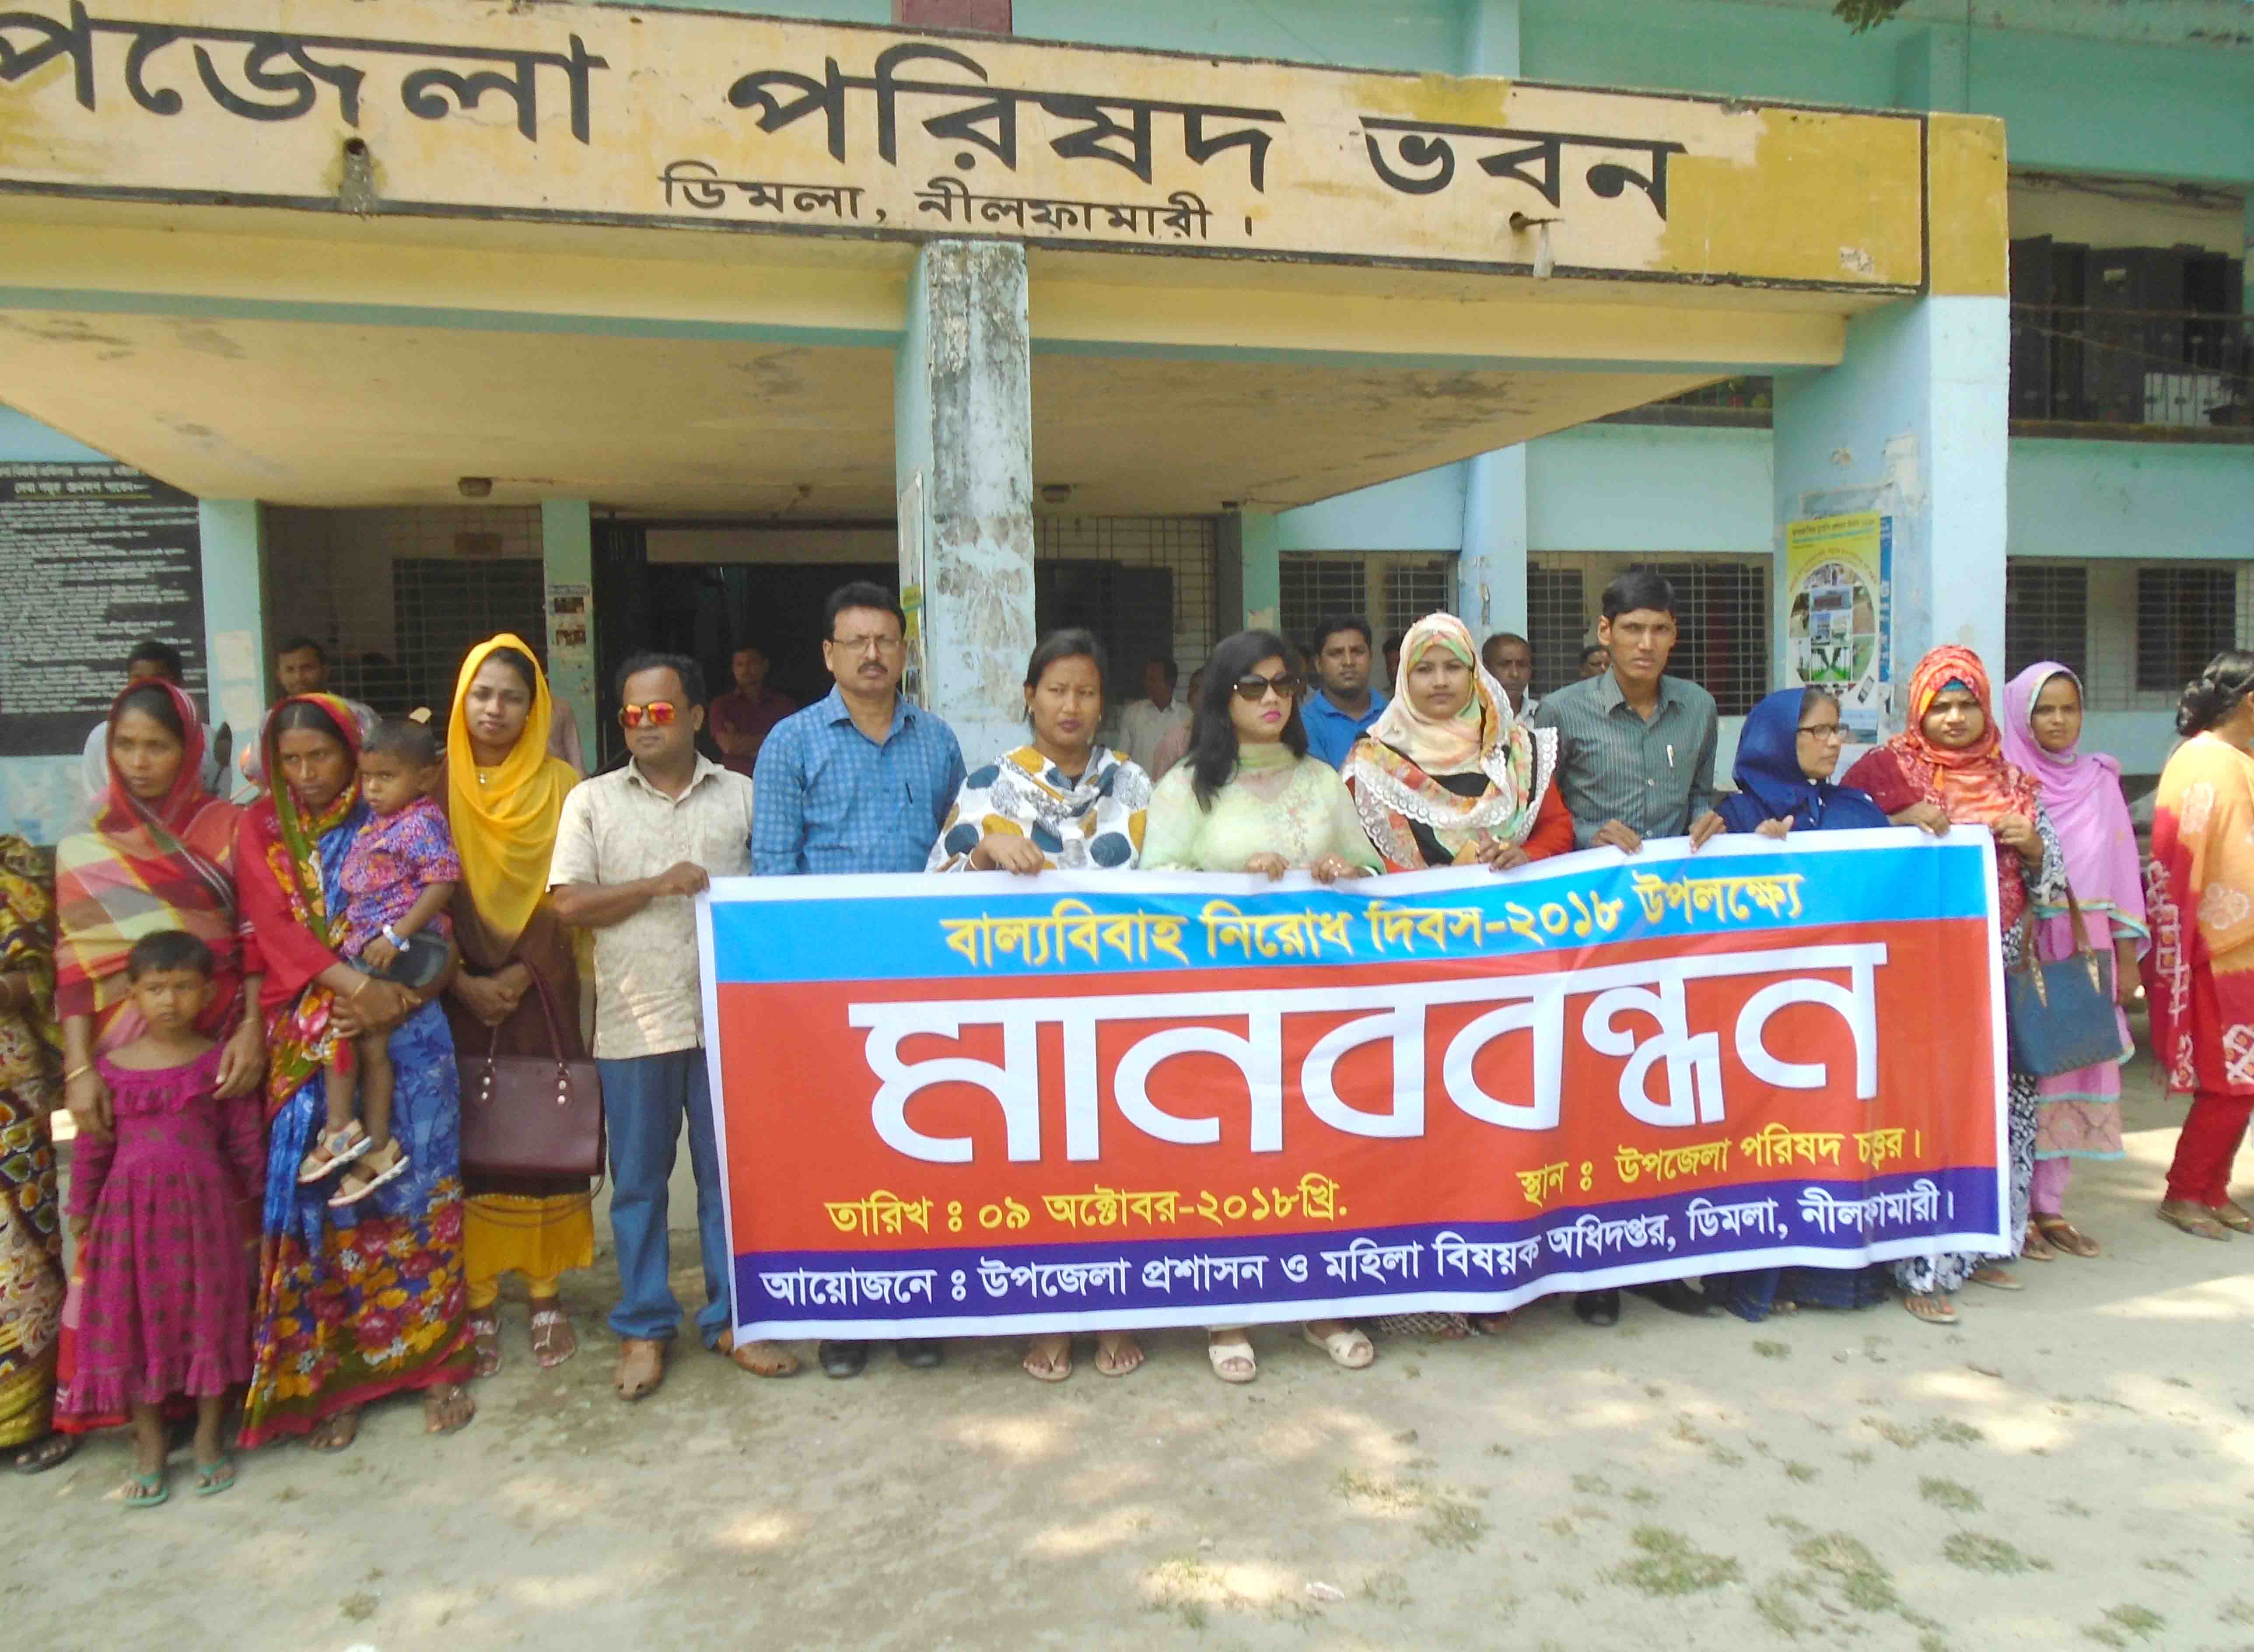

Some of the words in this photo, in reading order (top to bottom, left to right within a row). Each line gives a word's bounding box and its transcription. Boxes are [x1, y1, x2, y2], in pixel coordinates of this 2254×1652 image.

[728, 42, 1284, 192] পরিষদ
[1359, 116, 1689, 220] ভবন
[940, 898, 1189, 966] বাল্যবিবাহ
[1200, 900, 1354, 958] নিরোধ
[1632, 870, 1804, 924] উপলক্ষ্যে
[848, 943, 1887, 1163] মানববন্ধন
[1516, 1162, 1569, 1209] স্থান
[1614, 1138, 1732, 1181] উপজেলা
[1740, 1122, 1844, 1167] পরিষদ
[824, 1189, 934, 1236] তারিখ
[979, 1196, 1030, 1229] ০৯
[759, 1267, 938, 1306] আয়োজনে
[977, 1256, 1131, 1298] উপজেলা
[1142, 1253, 1269, 1294] প্রশাসন
[1280, 1255, 1308, 1284] ও
[1320, 1238, 1424, 1284] মহিলা
[1432, 1230, 1541, 1278] বিষয়ক
